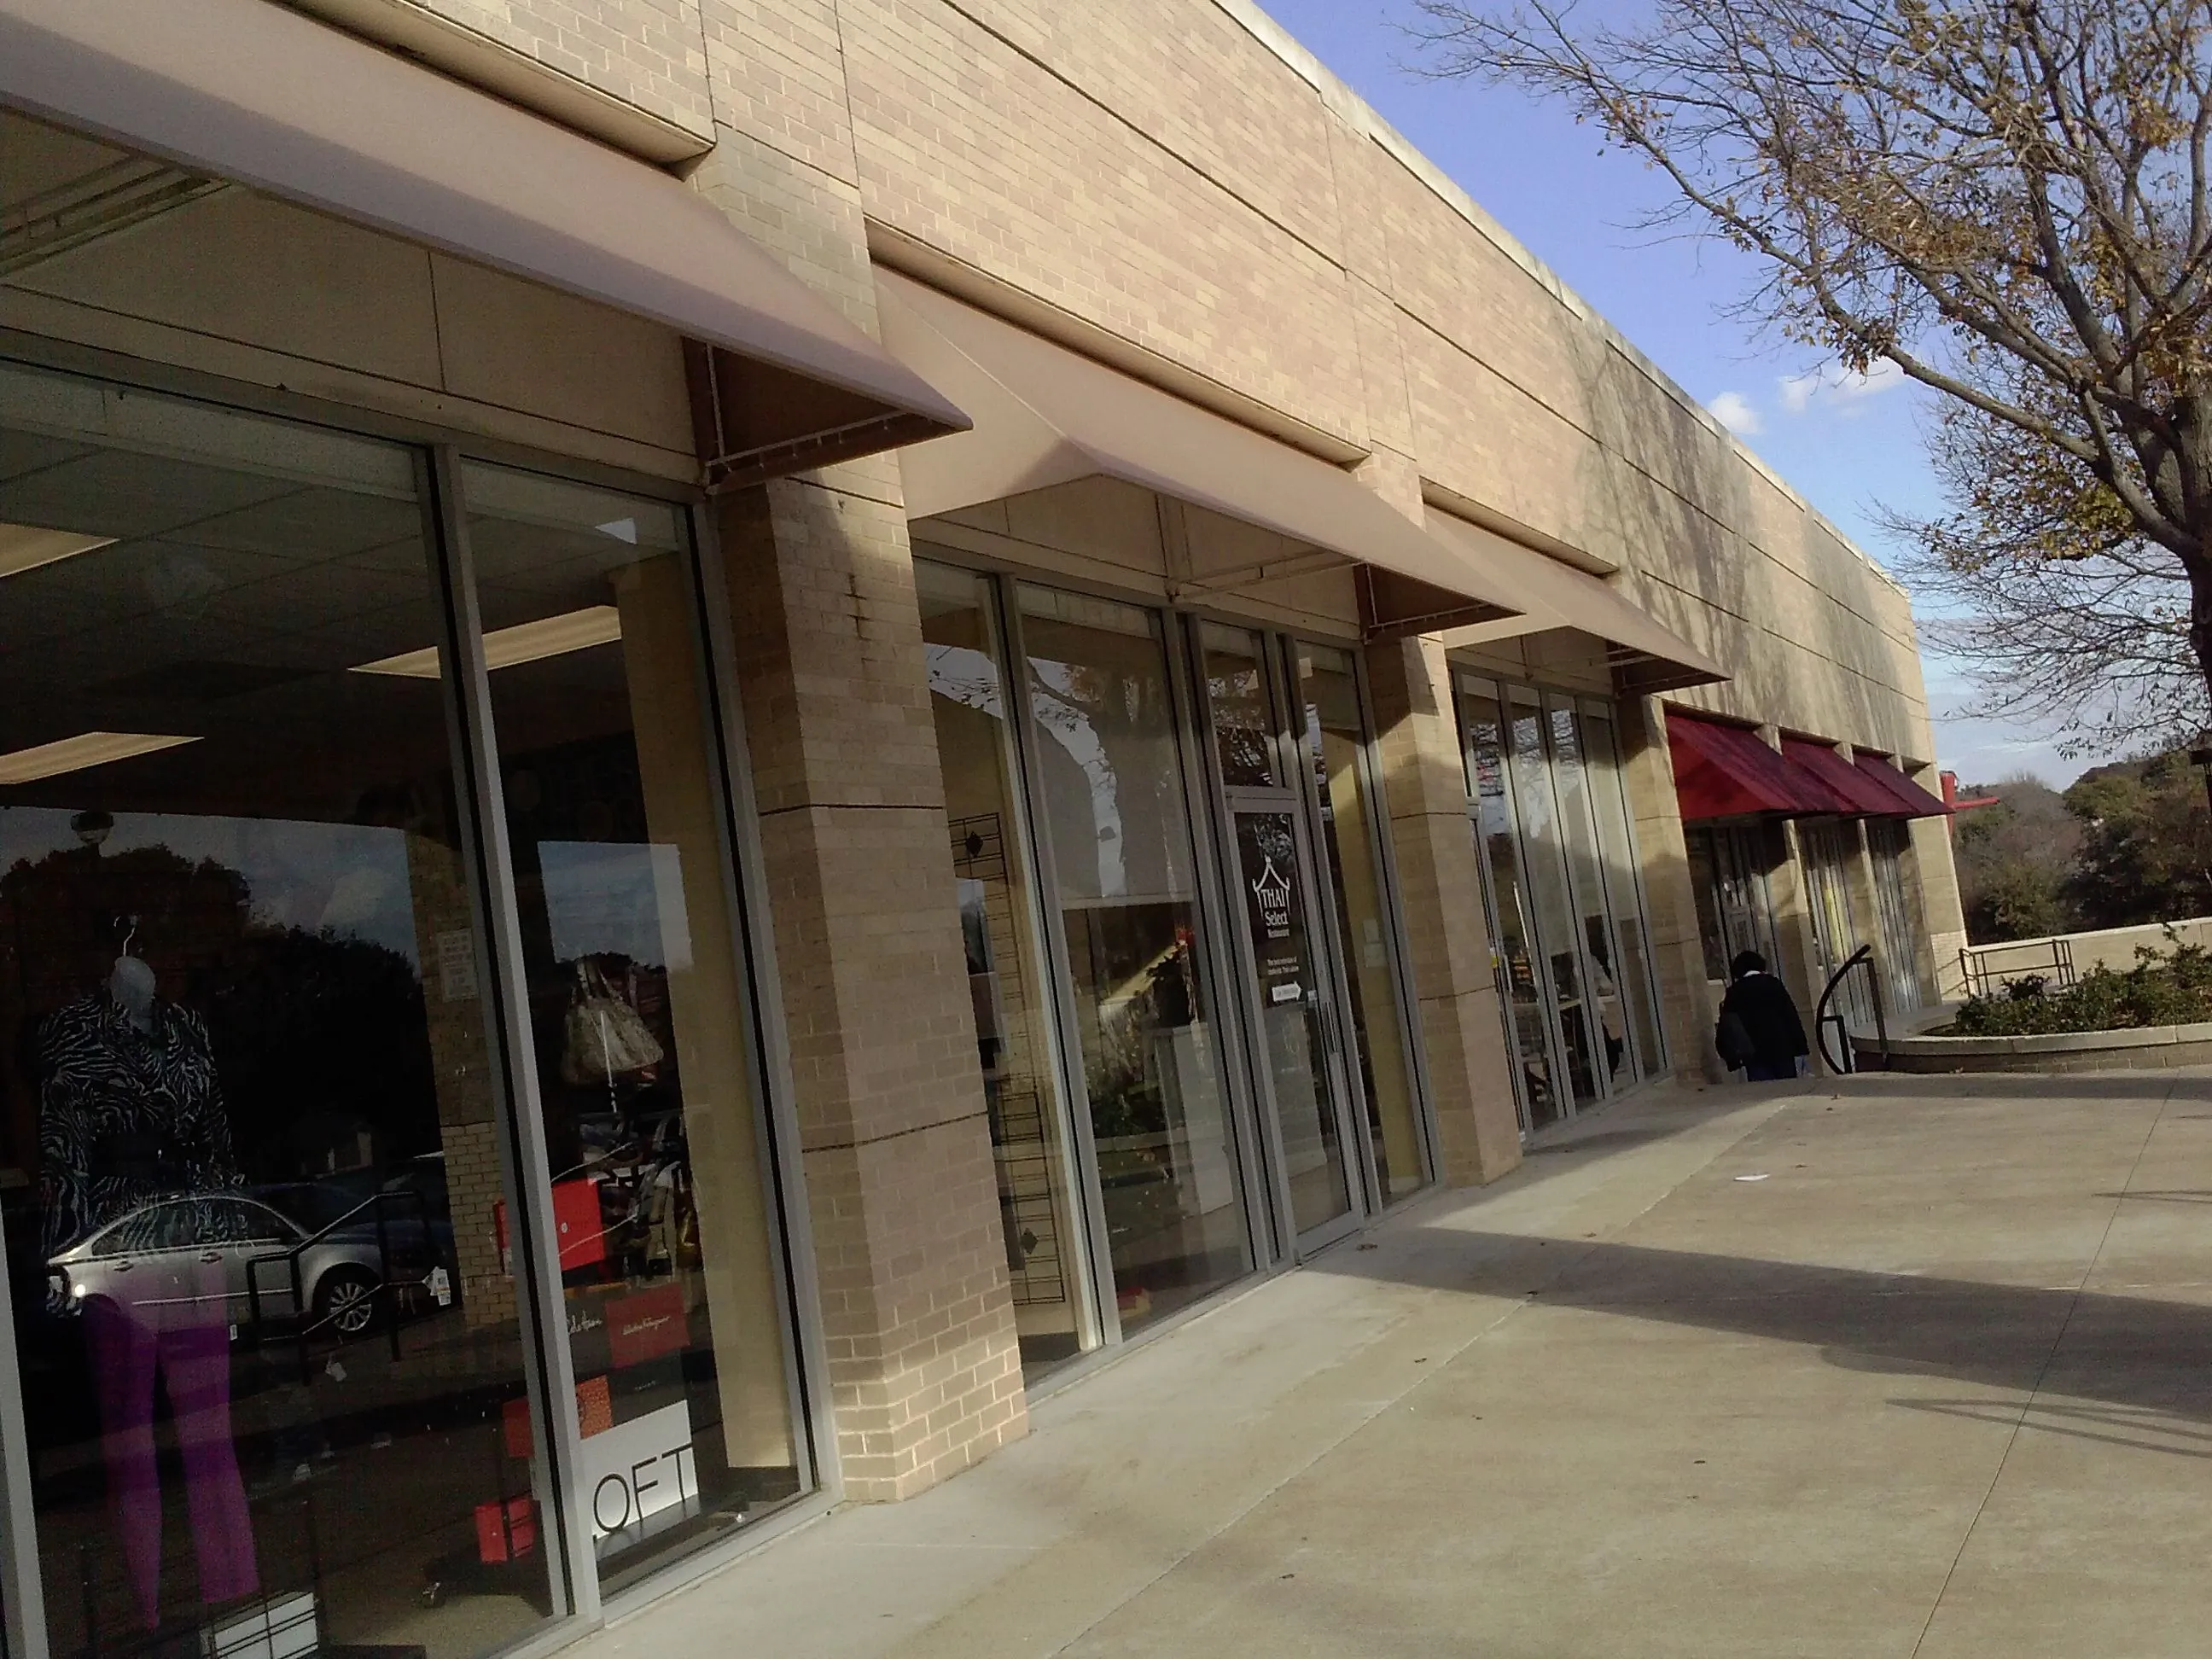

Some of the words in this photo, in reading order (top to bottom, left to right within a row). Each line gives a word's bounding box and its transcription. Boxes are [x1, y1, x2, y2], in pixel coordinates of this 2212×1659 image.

[1260, 888, 1286, 909] THAI
[1265, 911, 1289, 927] Select
[592, 1442, 693, 1536] OFT
